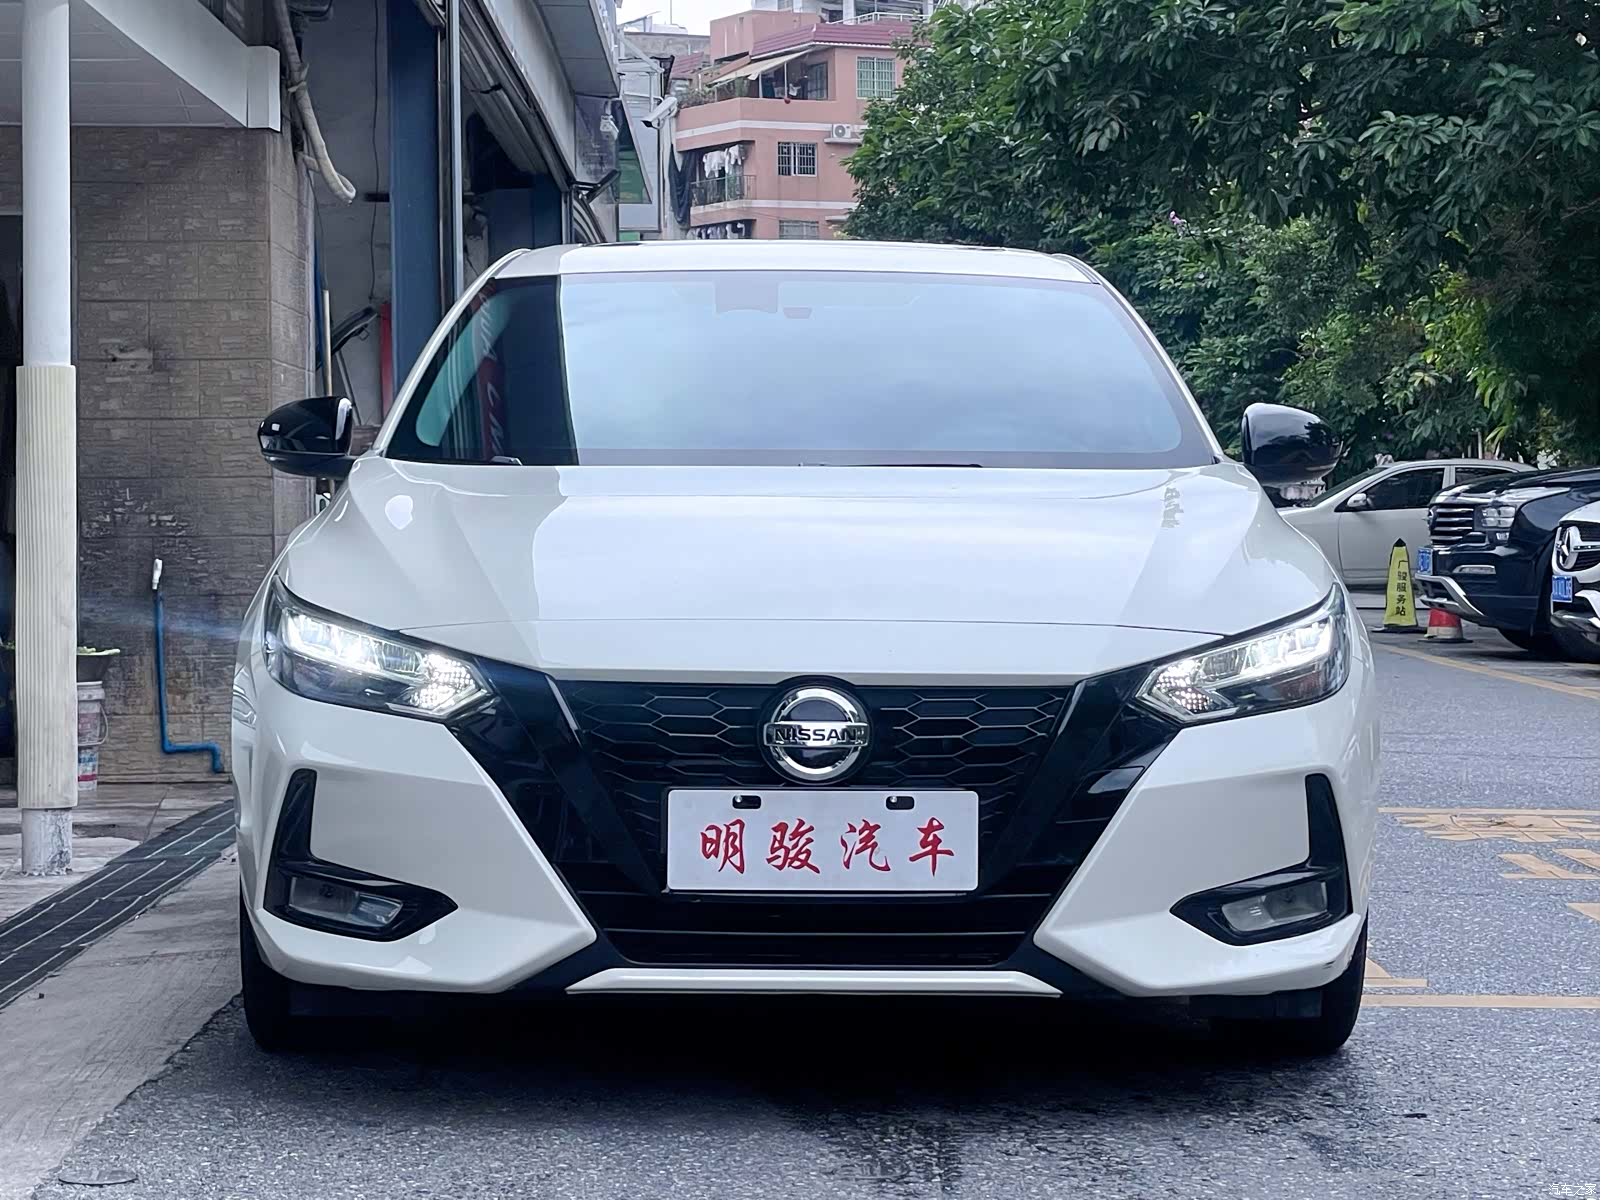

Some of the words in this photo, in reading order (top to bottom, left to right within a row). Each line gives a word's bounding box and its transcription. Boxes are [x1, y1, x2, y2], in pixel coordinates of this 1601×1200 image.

[775, 728, 857, 741] NISSAN
[700, 817, 954, 876] 明骏汽车
